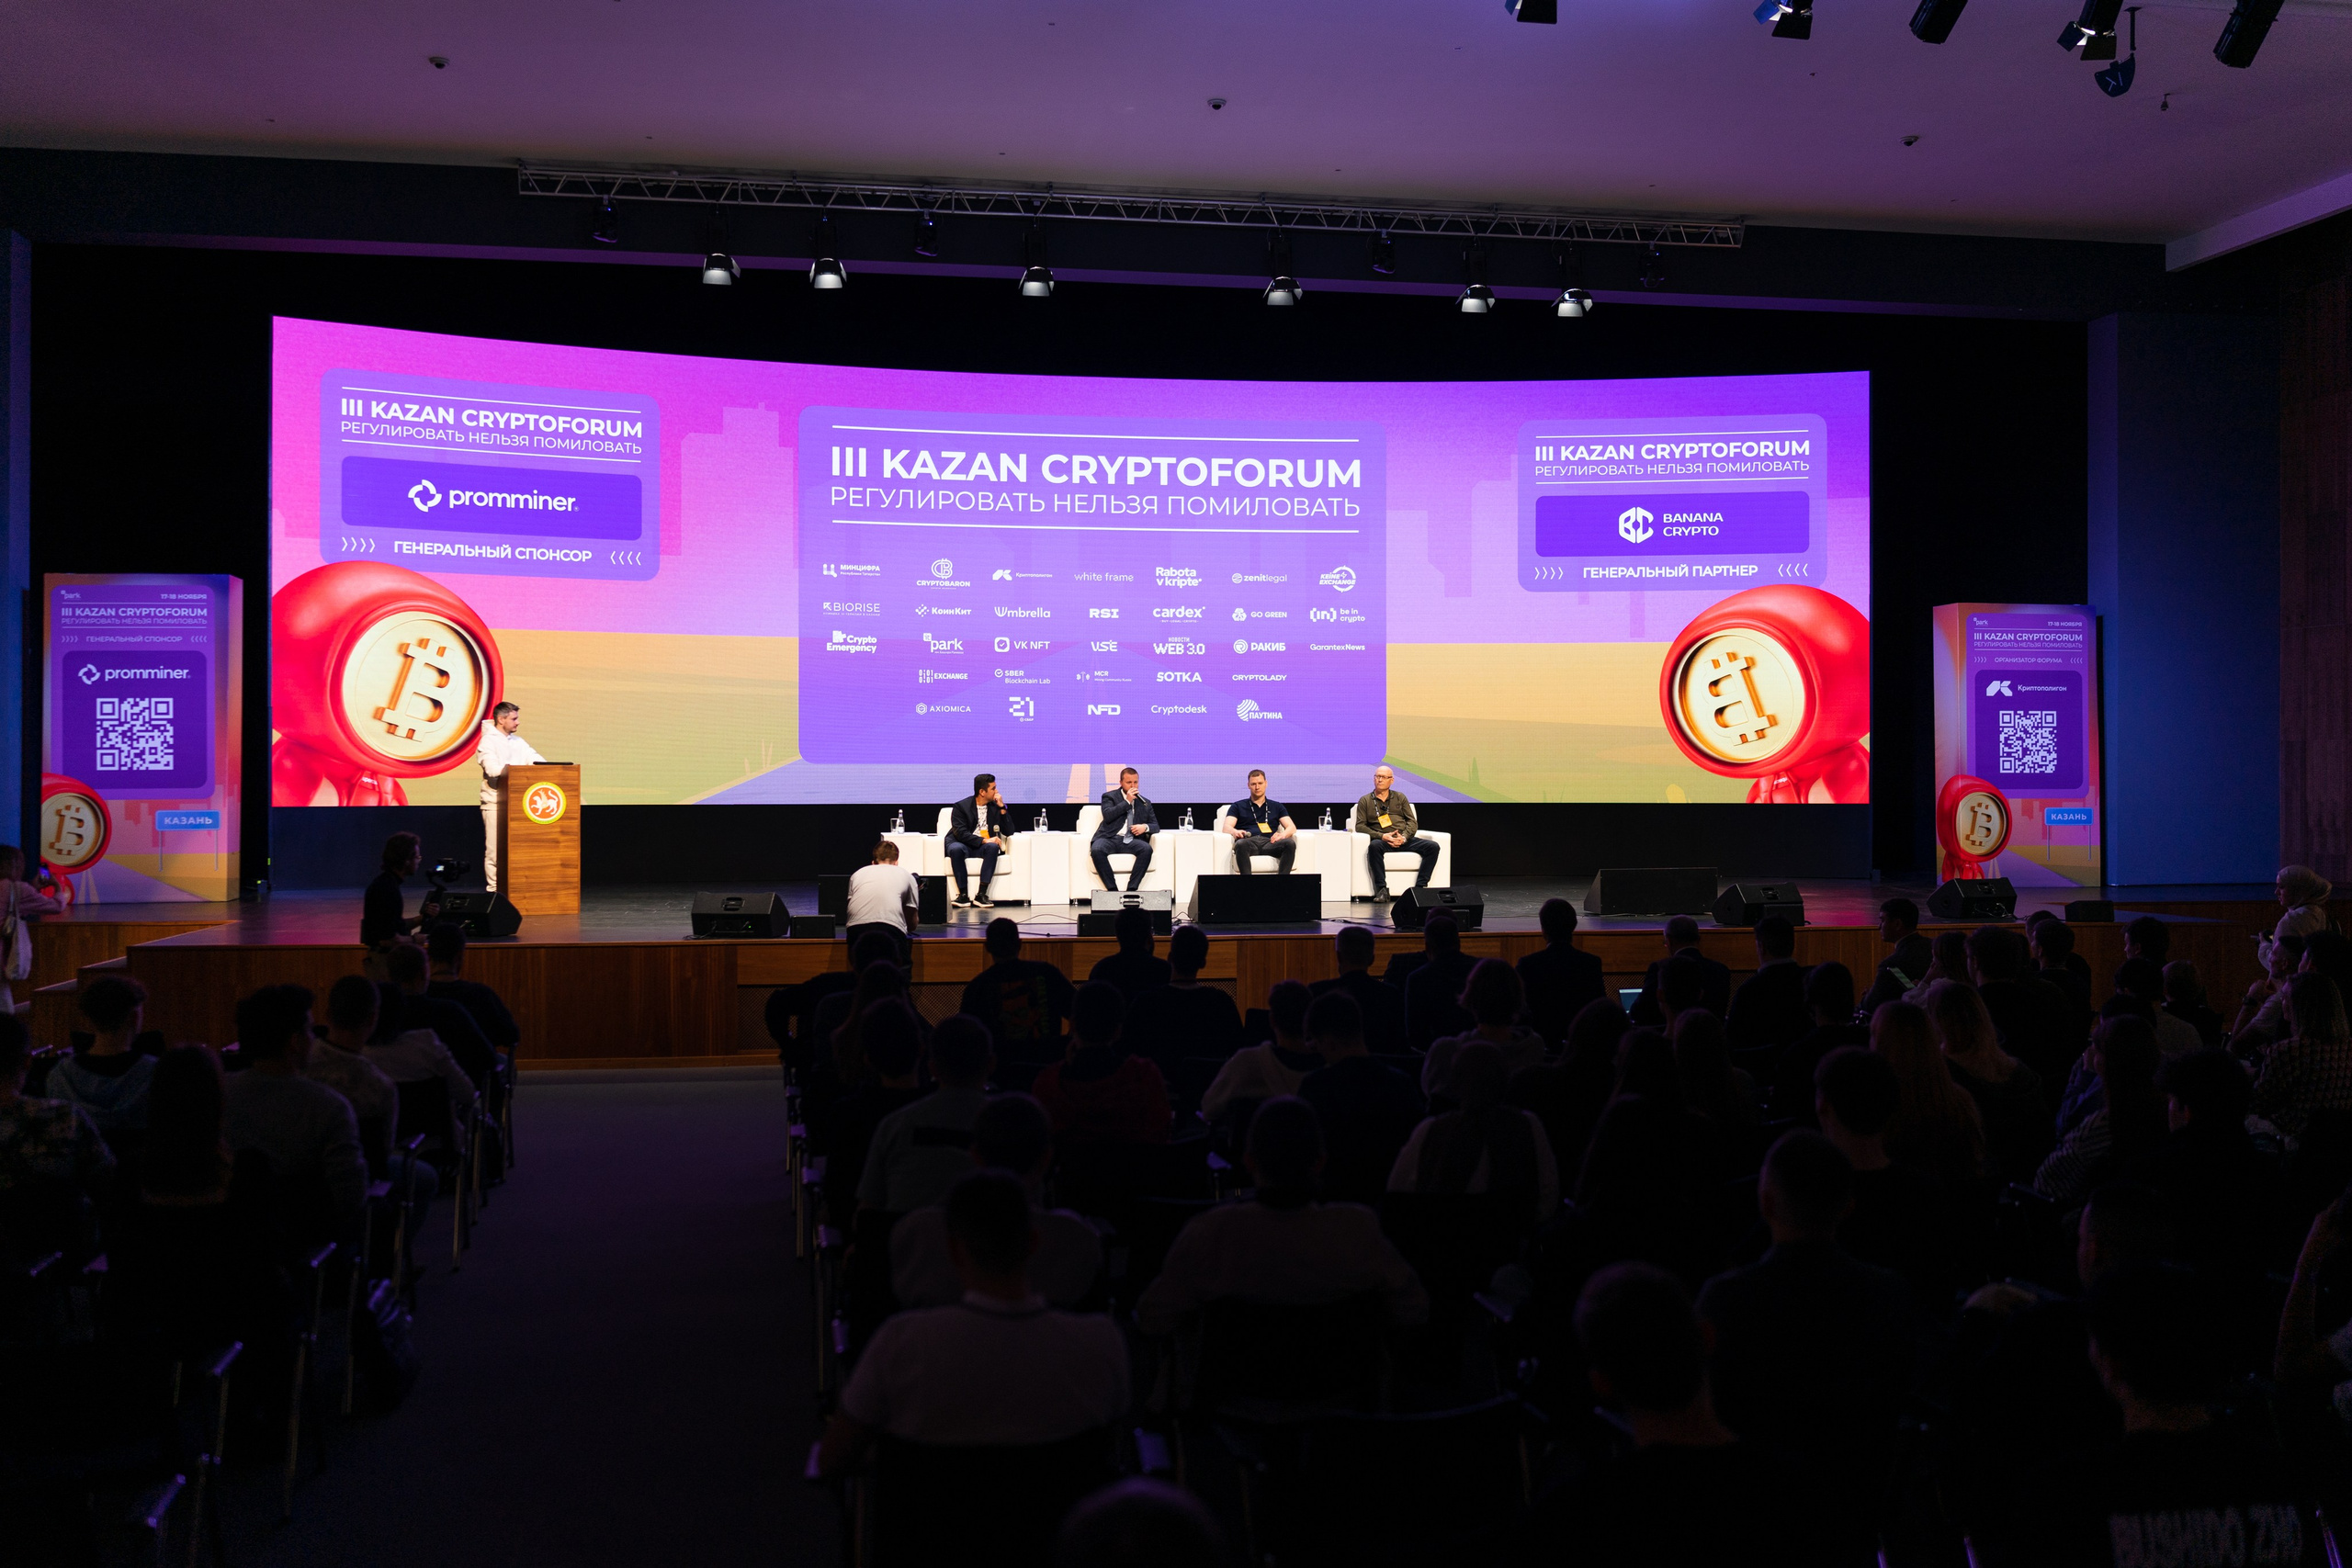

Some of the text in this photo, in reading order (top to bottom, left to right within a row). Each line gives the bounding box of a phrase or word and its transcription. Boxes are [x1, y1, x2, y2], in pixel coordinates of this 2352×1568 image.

[341, 398, 642, 438] III KAZAN CRYPTOFORUM
[341, 421, 642, 455] РЕГУЛИРОВАТЬ НЕЛЬЗЯ ПОМИЛОВАТЬ
[1535, 440, 1810, 461] III KAZAN CRYPTOFORUM
[831, 446, 1361, 489] III KAZAN CRYPTOFORUM
[1535, 460, 1809, 477] РЕГУЛИРОВАТЬ НЕЛЬЗЯ ПОМИЛОВАТЬ
[449, 489, 576, 513] promminer
[831, 487, 1360, 518] РЕГУЛИРОВАТЬ НЕЛЬЗЯ ПОМИЛОВАТЬ
[1663, 513, 1724, 524] BANANA
[1663, 525, 1719, 536] CRYPTO
[394, 540, 593, 563] ГЕНЕРАЛЬНЫЙ СПОНСОР
[840, 564, 881, 572] МИНЦИФРА
[1156, 567, 1196, 577] Rabota
[1583, 564, 1758, 579] ГЕНЕРАЛЬНЫЙ ПАРТНЕР
[1074, 572, 1134, 581] white frame
[1244, 574, 1287, 584] zenitlegal
[916, 580, 971, 588] CRYPTOBARON
[62, 608, 208, 616] III KAZAN CRYPTOFORUM
[833, 603, 880, 613] BIORISE
[1090, 608, 1119, 618] RSI
[1153, 606, 1203, 618] cardex
[847, 635, 877, 646] Crypto
[931, 637, 964, 653] park
[1013, 641, 1050, 649] VK NFT
[827, 643, 877, 654] Emergency
[1153, 644, 1205, 655] WEB 3.0
[1251, 643, 1286, 652] РАКИБ
[105, 666, 189, 682] promminer
[1156, 671, 1202, 682] SOTKA
[2018, 684, 2067, 693] Криптополигон
[1151, 705, 1207, 716] Cryptodesk
[164, 817, 212, 825] КАЗАНЬ
